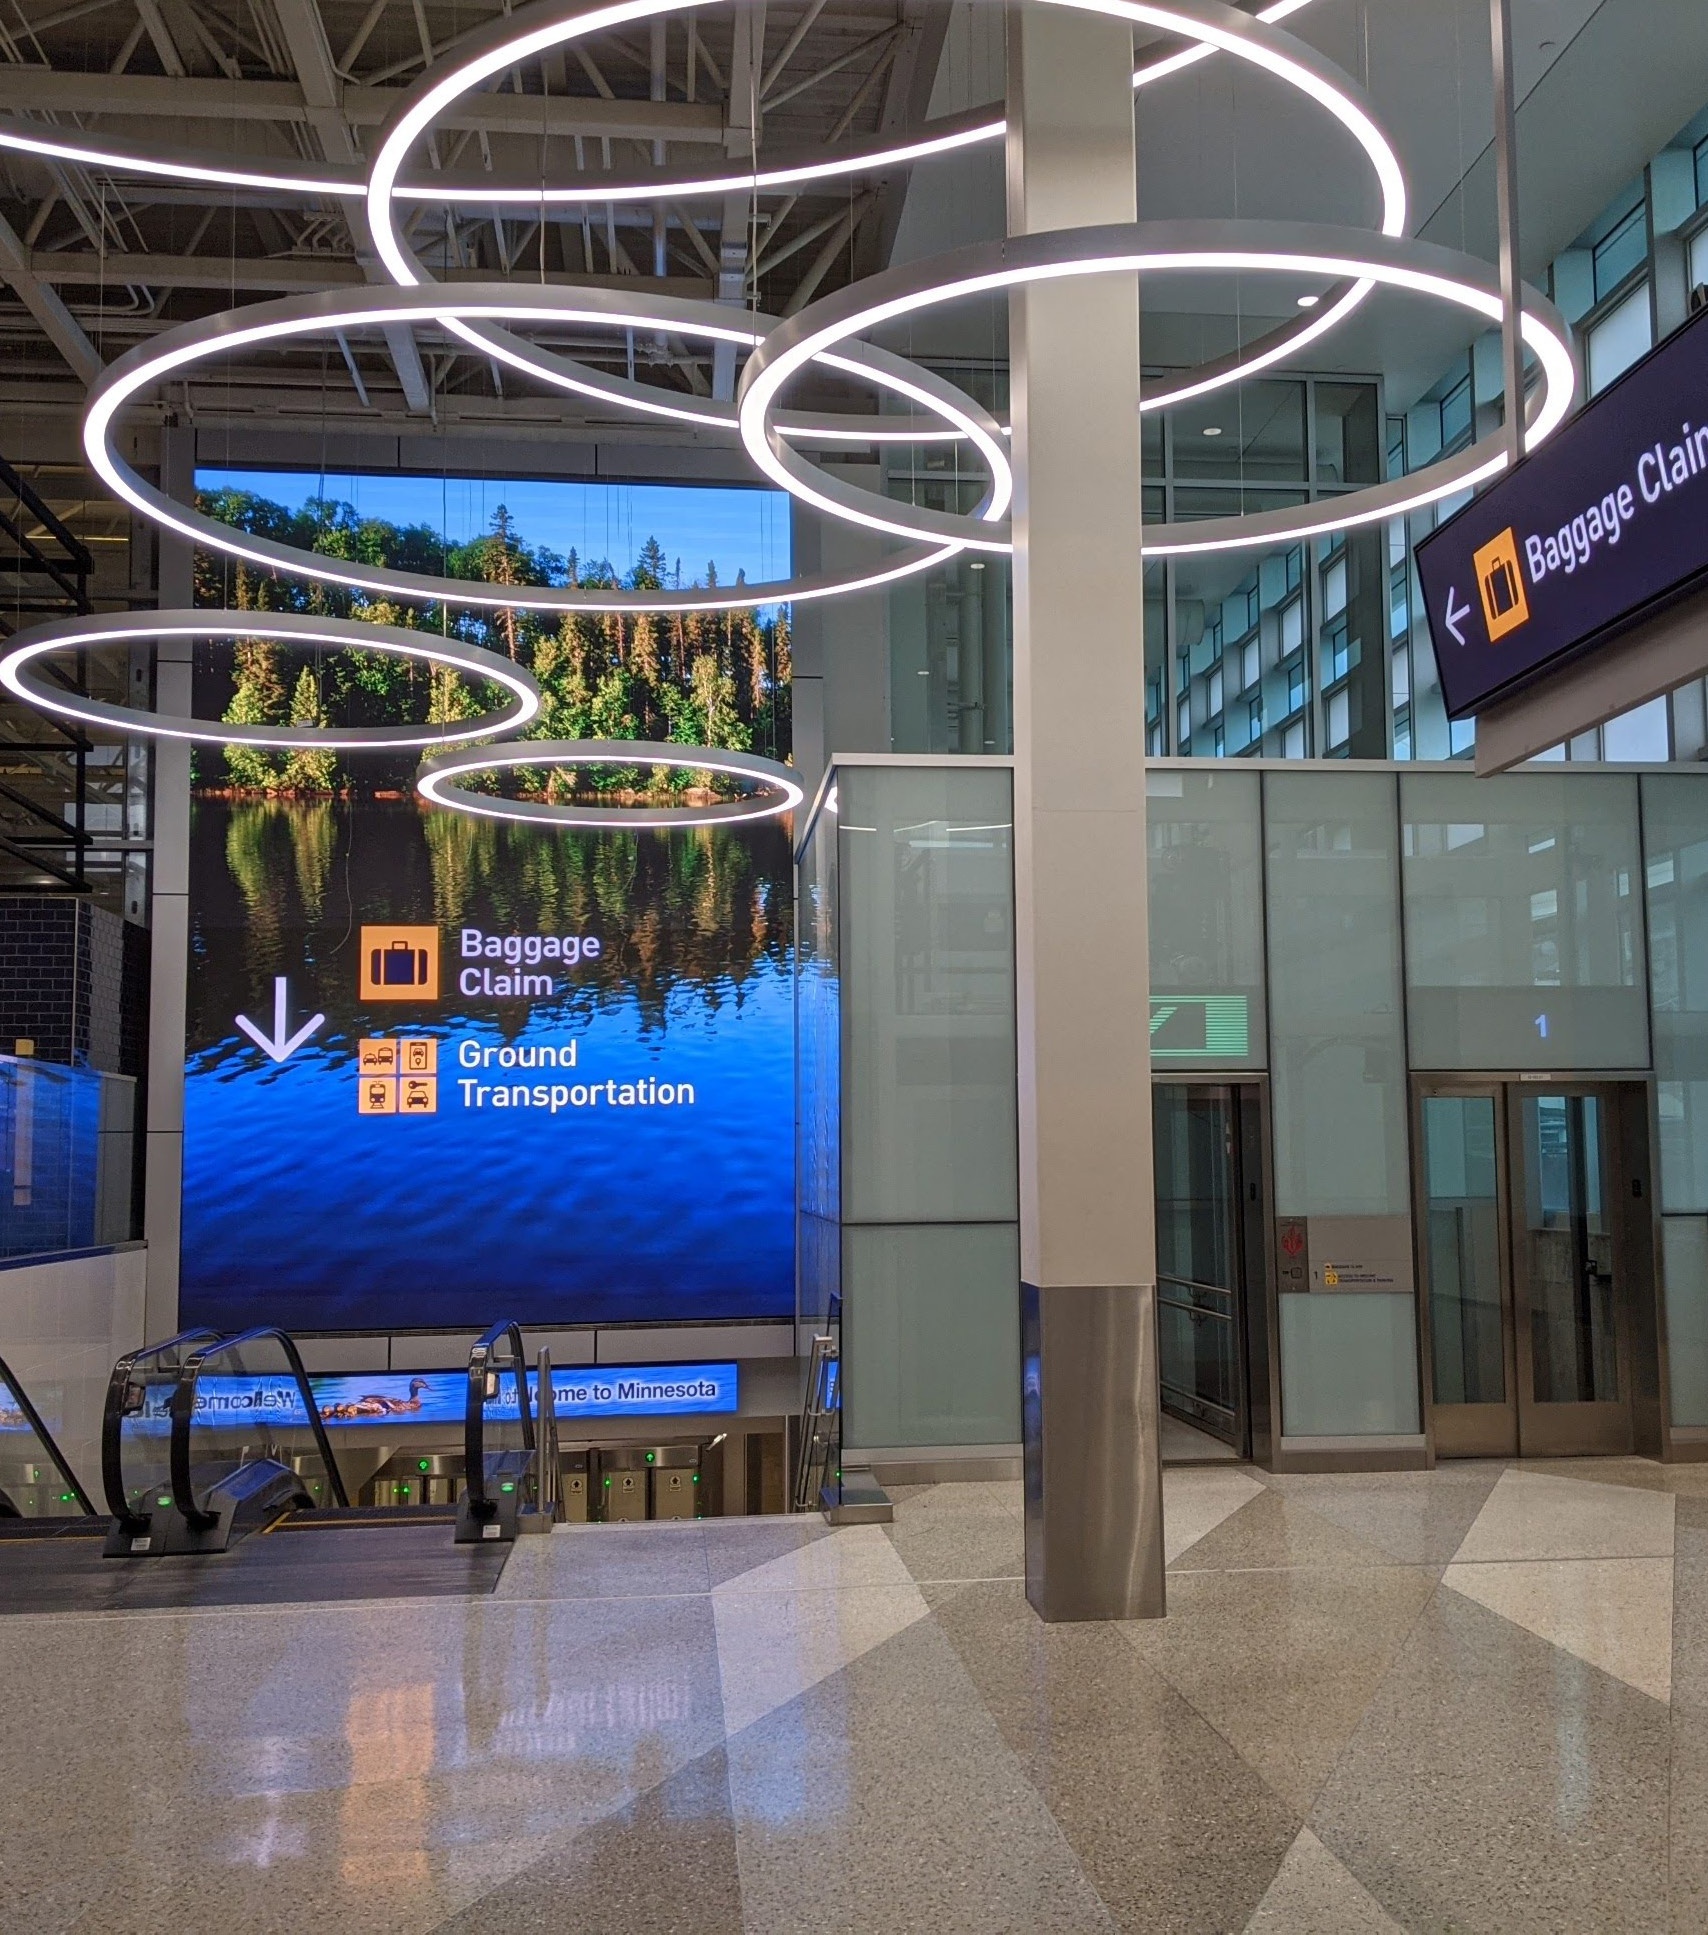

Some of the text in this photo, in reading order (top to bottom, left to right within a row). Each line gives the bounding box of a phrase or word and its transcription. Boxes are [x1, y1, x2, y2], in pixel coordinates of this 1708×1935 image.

[1525, 485, 1635, 584] Baggage
[461, 928, 600, 964] Baggage
[459, 968, 553, 997] Claim
[1534, 1014, 1548, 1038] 1
[458, 1039, 578, 1068] Ground
[458, 1077, 696, 1113] Transportation
[592, 1384, 612, 1401] to
[617, 1381, 717, 1401] Minnesota
